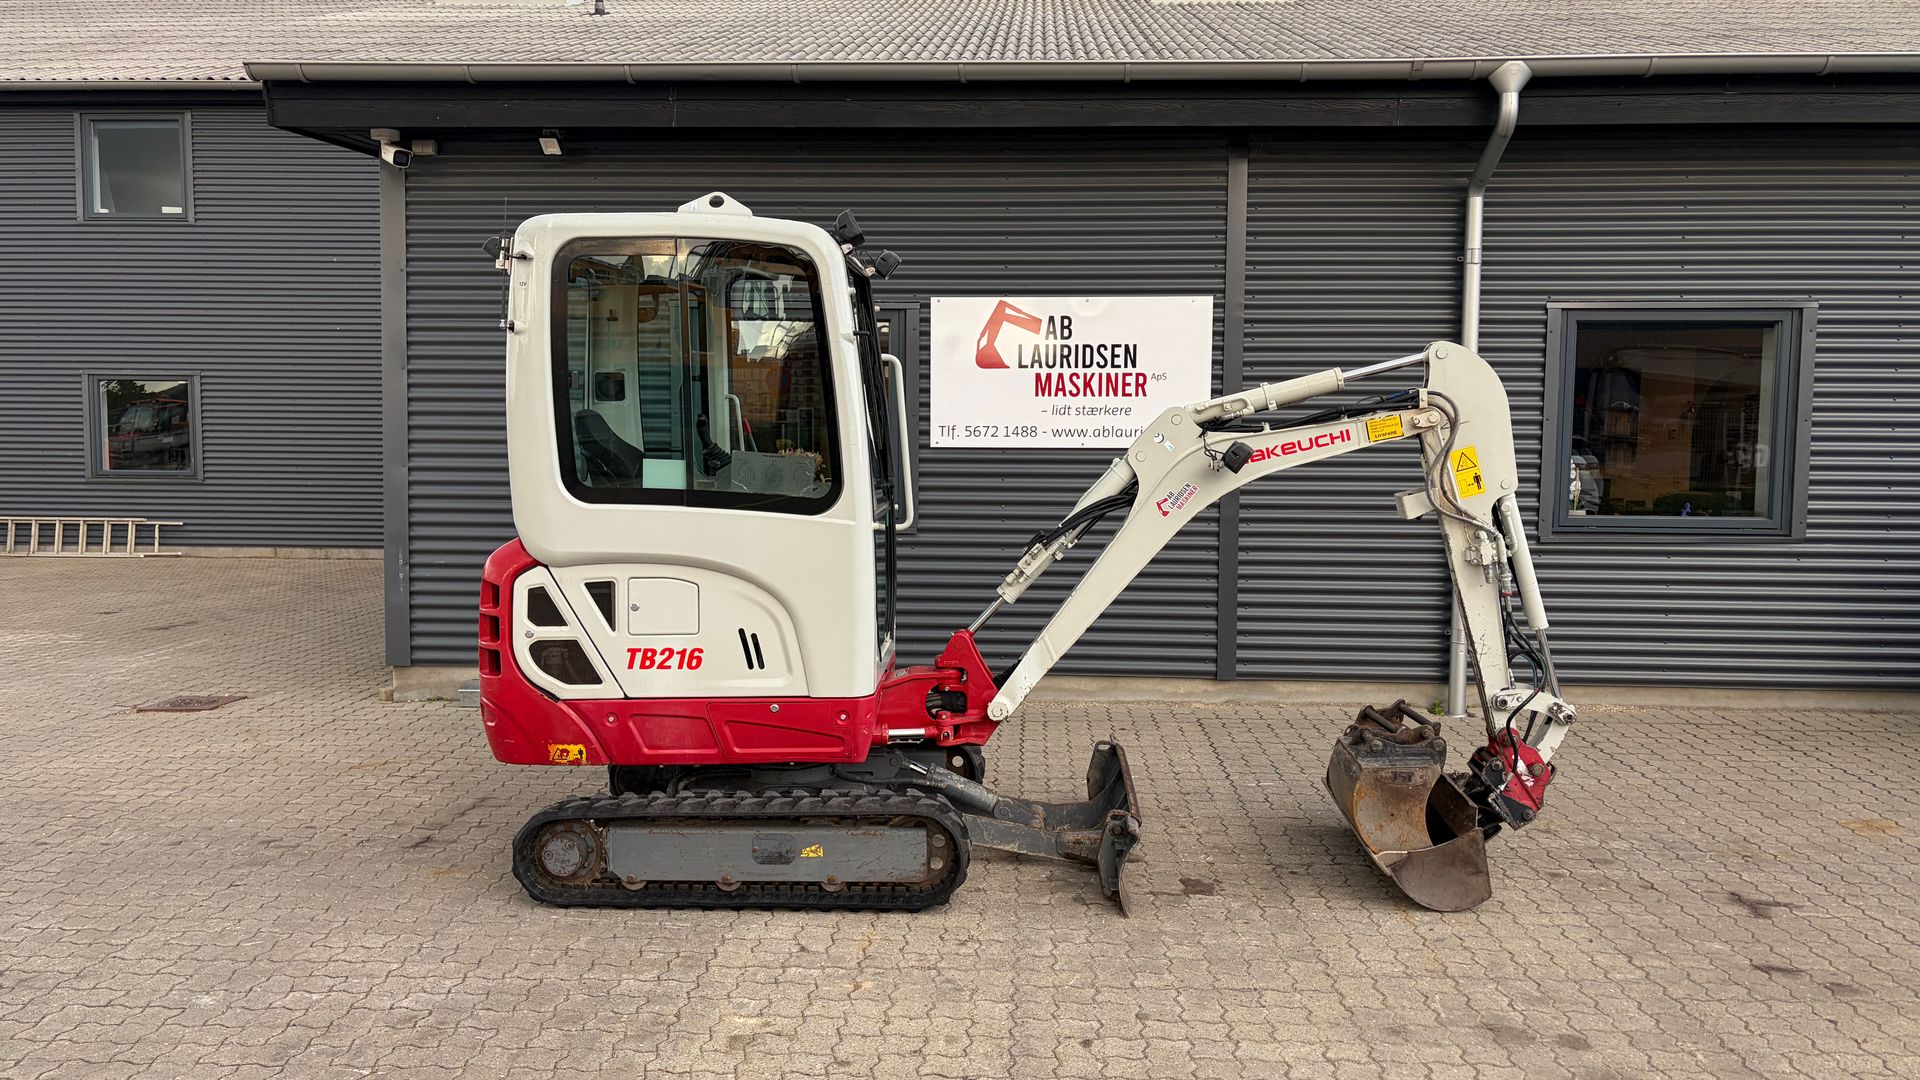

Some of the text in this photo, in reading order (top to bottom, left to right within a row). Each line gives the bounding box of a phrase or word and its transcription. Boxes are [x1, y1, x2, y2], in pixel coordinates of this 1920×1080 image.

[1044, 315, 1073, 341] AB
[1017, 343, 1138, 369] LAURIDSEN
[1034, 372, 1168, 398] MASKINER ApS
[1051, 404, 1073, 416] lidt
[1074, 404, 1132, 416] stærkere
[938, 425, 960, 440] Tlf.
[964, 425, 999, 438] 5672
[1003, 425, 1038, 438] 1488
[1167, 490, 1175, 500] AB
[1167, 483, 1191, 509] LAURIDSEN
[1176, 485, 1198, 510] MASKINER
[626, 647, 704, 670] TB216
